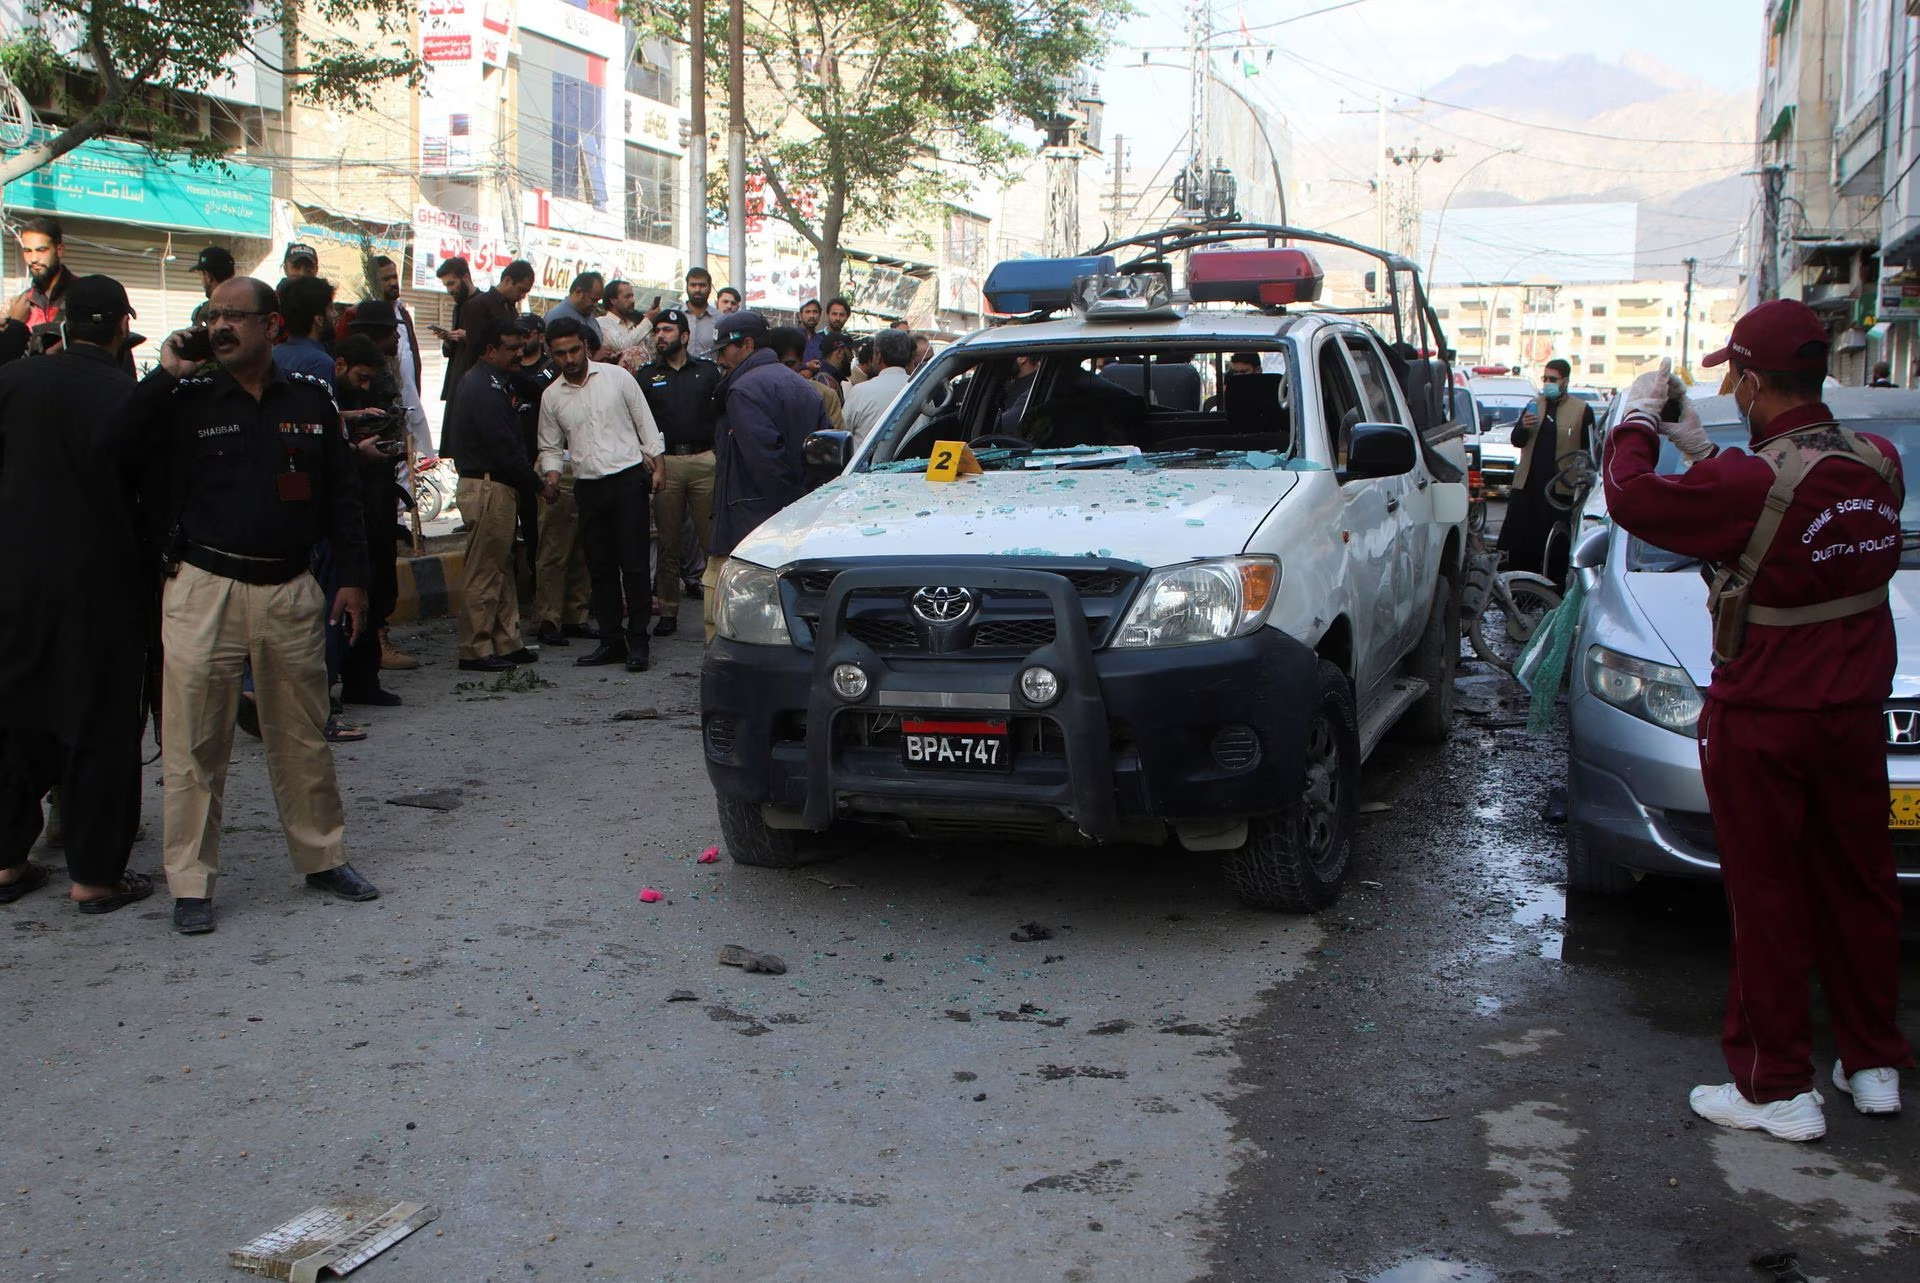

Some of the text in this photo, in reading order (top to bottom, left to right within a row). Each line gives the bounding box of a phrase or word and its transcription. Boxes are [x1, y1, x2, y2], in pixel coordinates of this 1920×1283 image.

[418, 208, 460, 231] GHAZI
[198, 424, 241, 438] SHABBAR
[934, 451, 952, 470] 2
[1801, 498, 1899, 544] CRIME SCENE UNIT
[1811, 535, 1896, 562] QUETTA POLICE
[906, 735, 1000, 765] BPA-747
